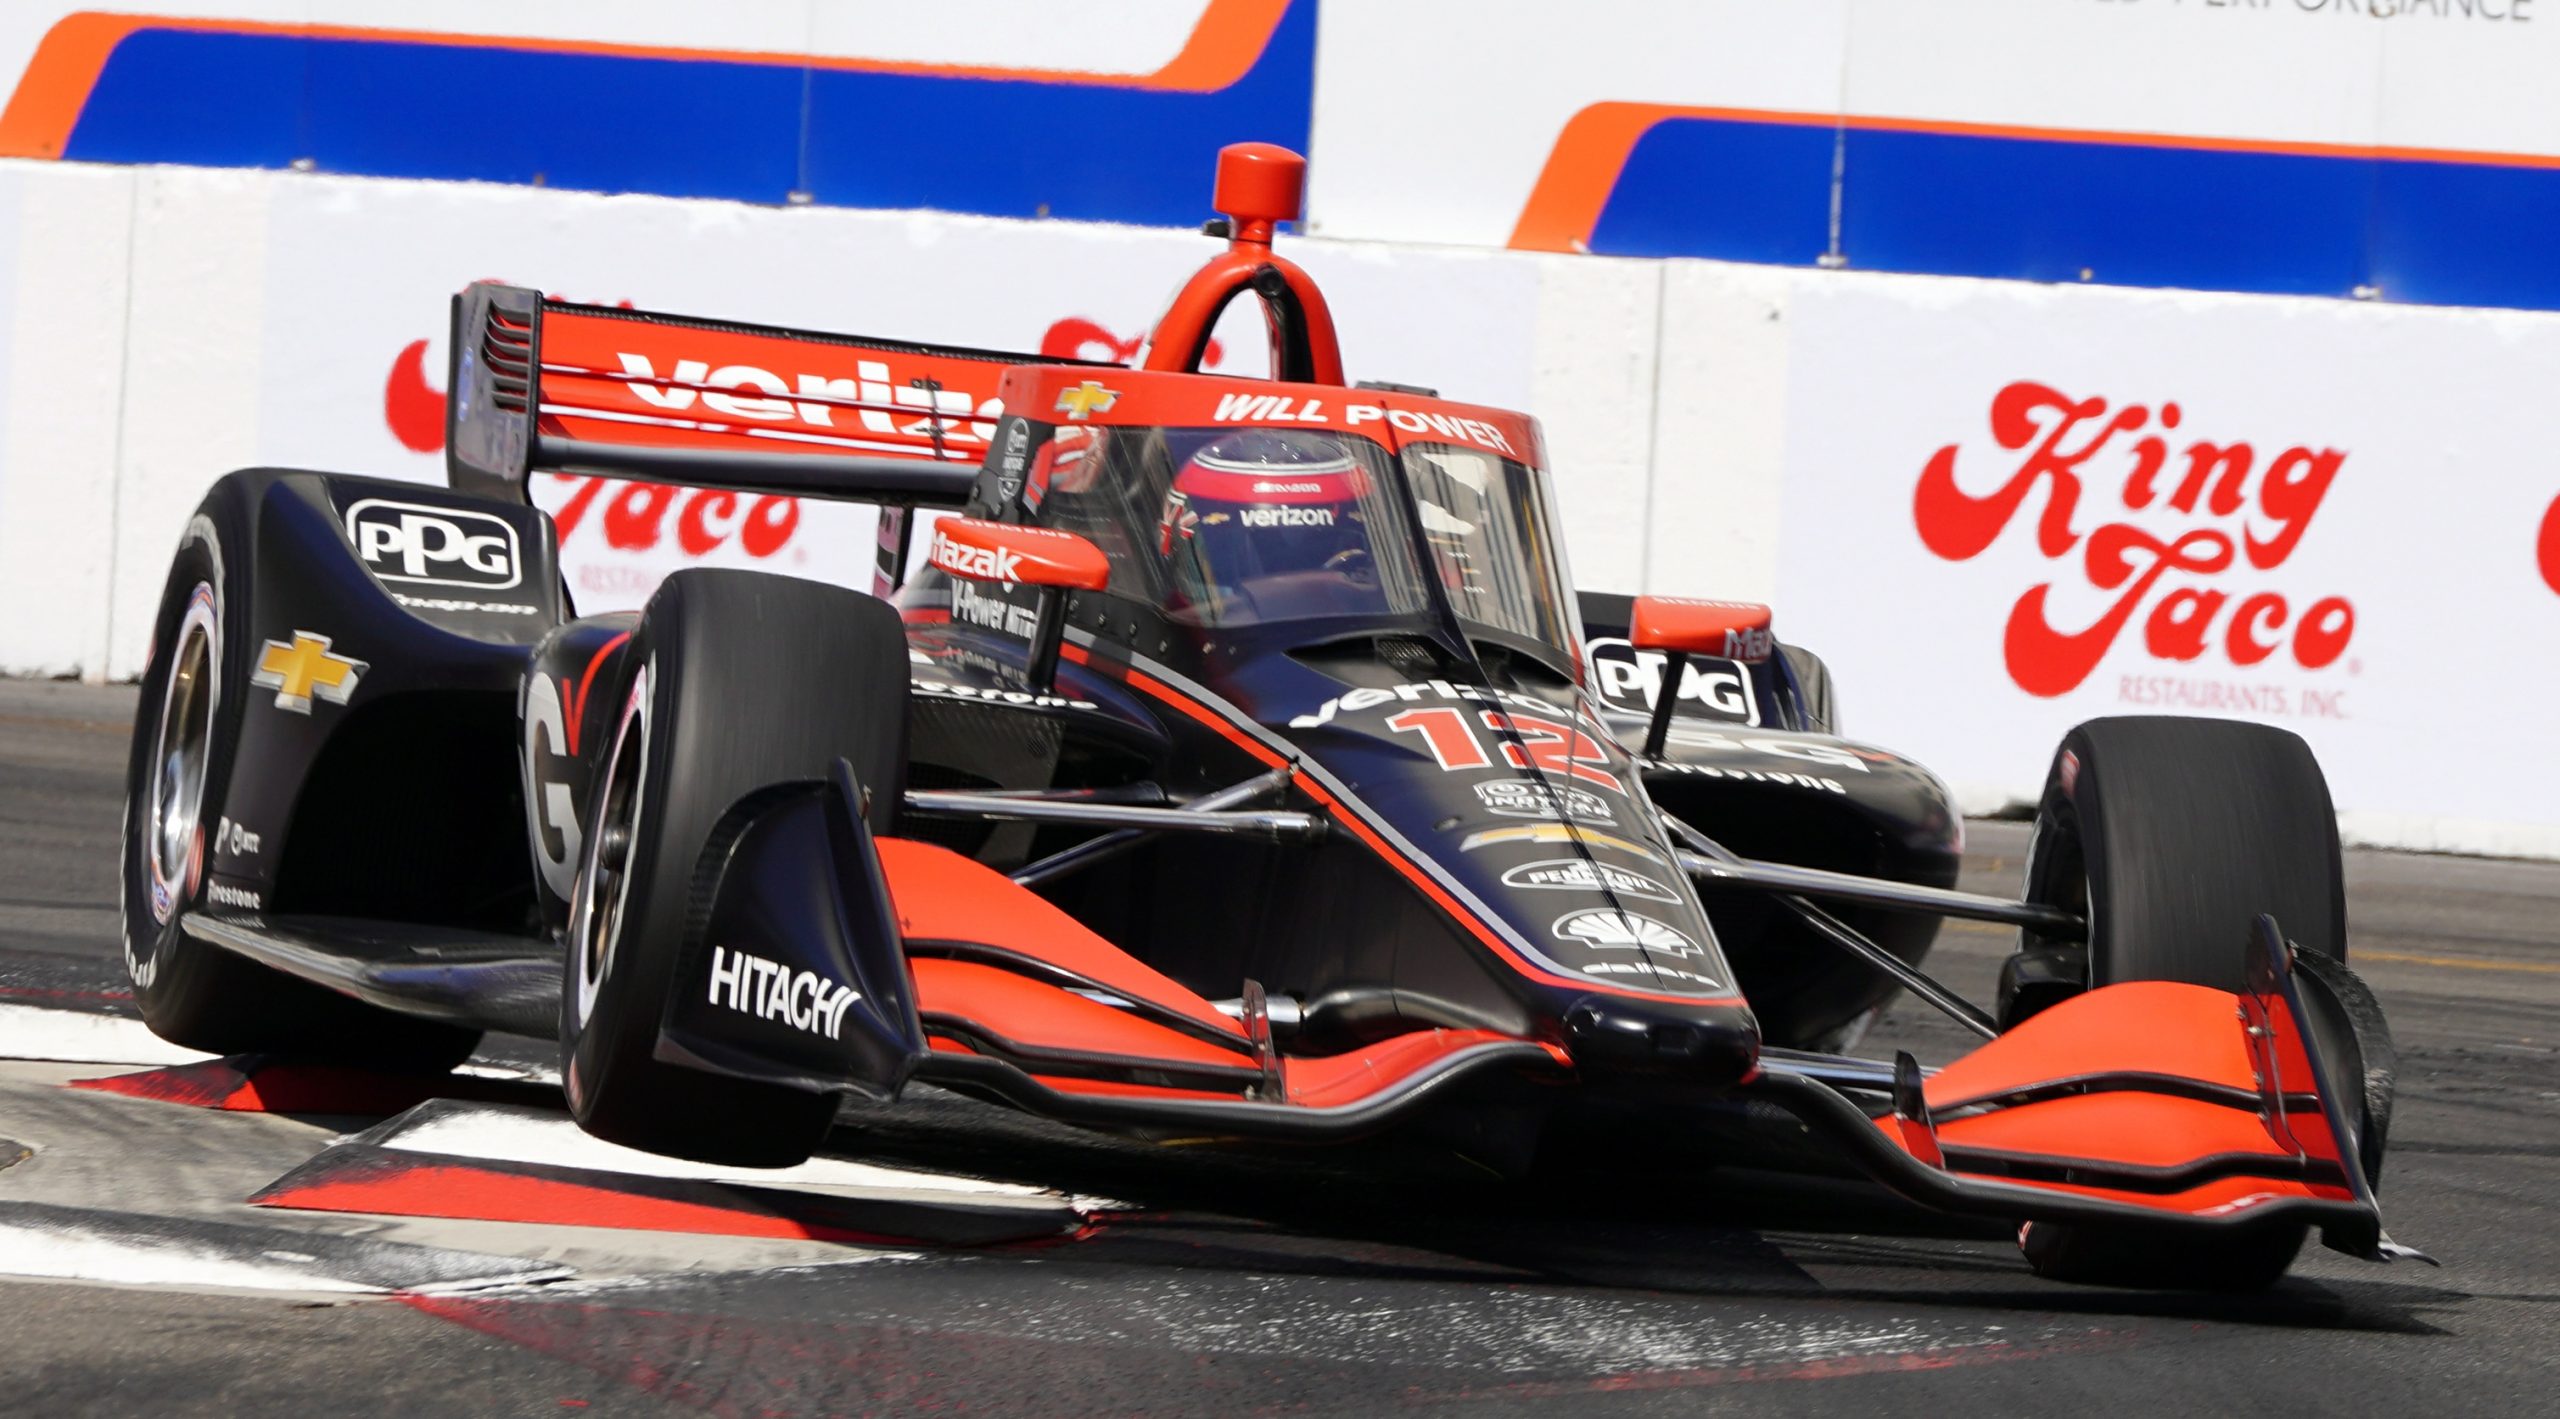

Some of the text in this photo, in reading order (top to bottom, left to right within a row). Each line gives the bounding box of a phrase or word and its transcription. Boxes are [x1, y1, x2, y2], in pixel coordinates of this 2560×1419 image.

[617, 352, 1005, 442] veriz
[1213, 393, 1517, 457] WILL POWER
[1912, 380, 2350, 571] King
[359, 513, 510, 577] PPG
[1239, 505, 1335, 527] verizon
[931, 529, 1023, 583] Mazak
[2003, 522, 2356, 698] Taco
[2118, 674, 2290, 717] RESTAURANTS,
[1384, 706, 1630, 798] 12
[708, 945, 863, 1041] HITACHI
